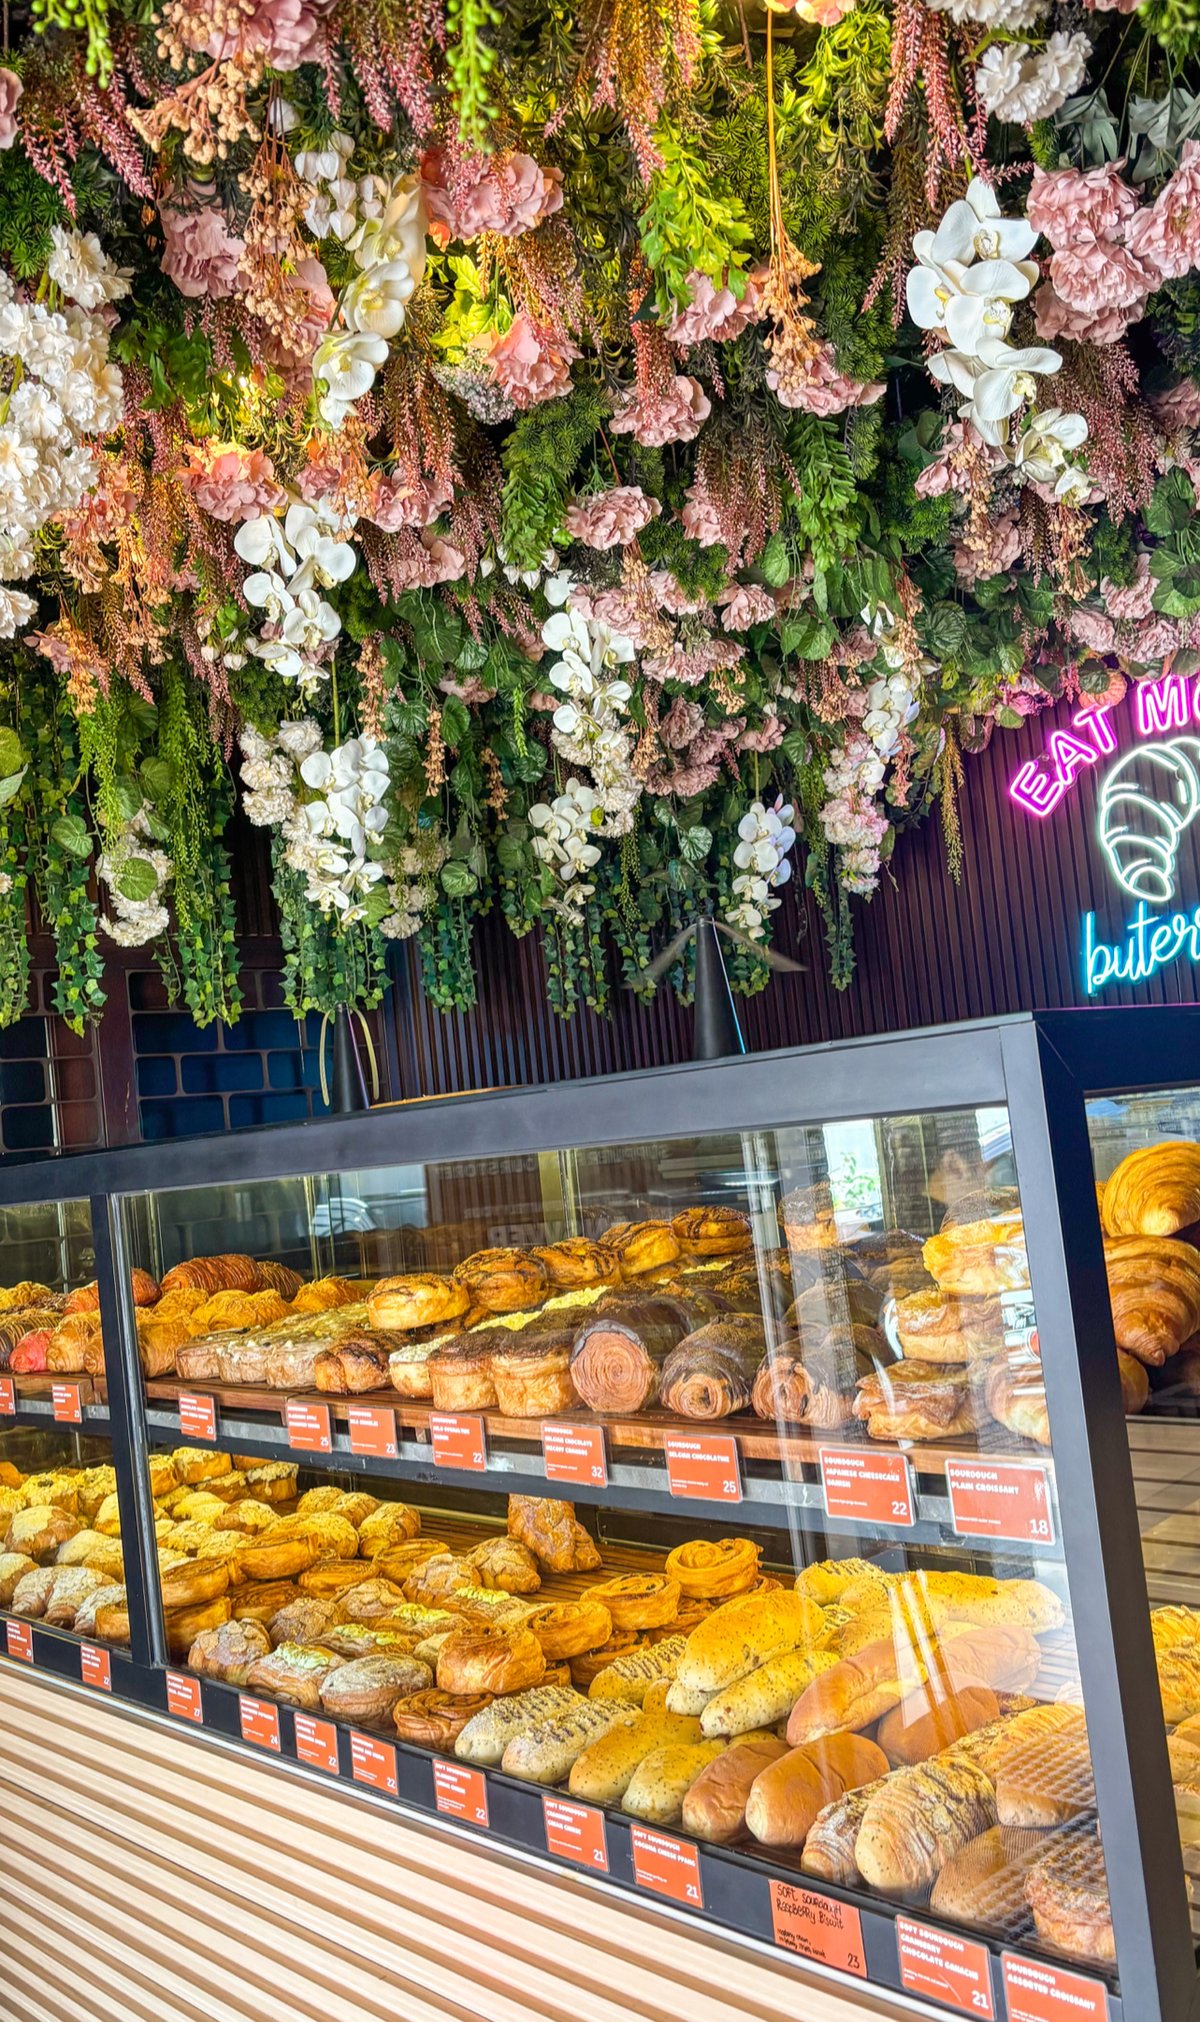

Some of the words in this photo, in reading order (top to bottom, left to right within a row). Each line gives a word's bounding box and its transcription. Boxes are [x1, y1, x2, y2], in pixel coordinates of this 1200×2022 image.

[1008, 702, 1118, 818] EAT
[1136, 674, 1200, 736] M
[1083, 900, 1200, 995] buter
[667, 1440, 702, 1451] SOURDOUGH
[472, 1451, 483, 1464] 22
[668, 1451, 691, 1460] BELGIAN
[823, 1456, 865, 1468] SOURDOUGH
[591, 1465, 603, 1479] 32
[825, 1468, 857, 1478] JAPANESE
[858, 1471, 900, 1482] CHEESECAKE
[949, 1469, 998, 1481] SOURDOUGH
[722, 1480, 737, 1494] 25
[826, 1478, 851, 1488] DANISH
[951, 1481, 974, 1491] PLAIN
[975, 1483, 1019, 1495] CROISSANT
[891, 1500, 908, 1516] 22
[1029, 1518, 1049, 1536] 18
[328, 1755, 337, 1768] 22
[386, 1776, 396, 1790] 22
[475, 1807, 486, 1820] 22
[545, 1801, 558, 1809] SOFT
[558, 1803, 588, 1818] SOURDOUGH
[633, 1829, 648, 1840] SOFT
[647, 1834, 681, 1851] SOURDOUGH
[593, 1848, 605, 1863] 21
[657, 1847, 677, 1860] CHEESE
[685, 1883, 699, 1900] 21
[899, 1921, 918, 1934] SOFT
[918, 1928, 965, 1953] SOURDOUGH
[900, 1933, 941, 1954] CRANBERRY
[847, 1953, 860, 1969] 23
[901, 1945, 943, 1967] CHOCOLATE
[944, 1961, 979, 1981] GANACHE
[1005, 1961, 1056, 1985] SOURDOUGH
[971, 1990, 990, 2010] 21
[1007, 1974, 1049, 1994] ASSORTED
[1049, 1988, 1096, 2011] CROISSANT
